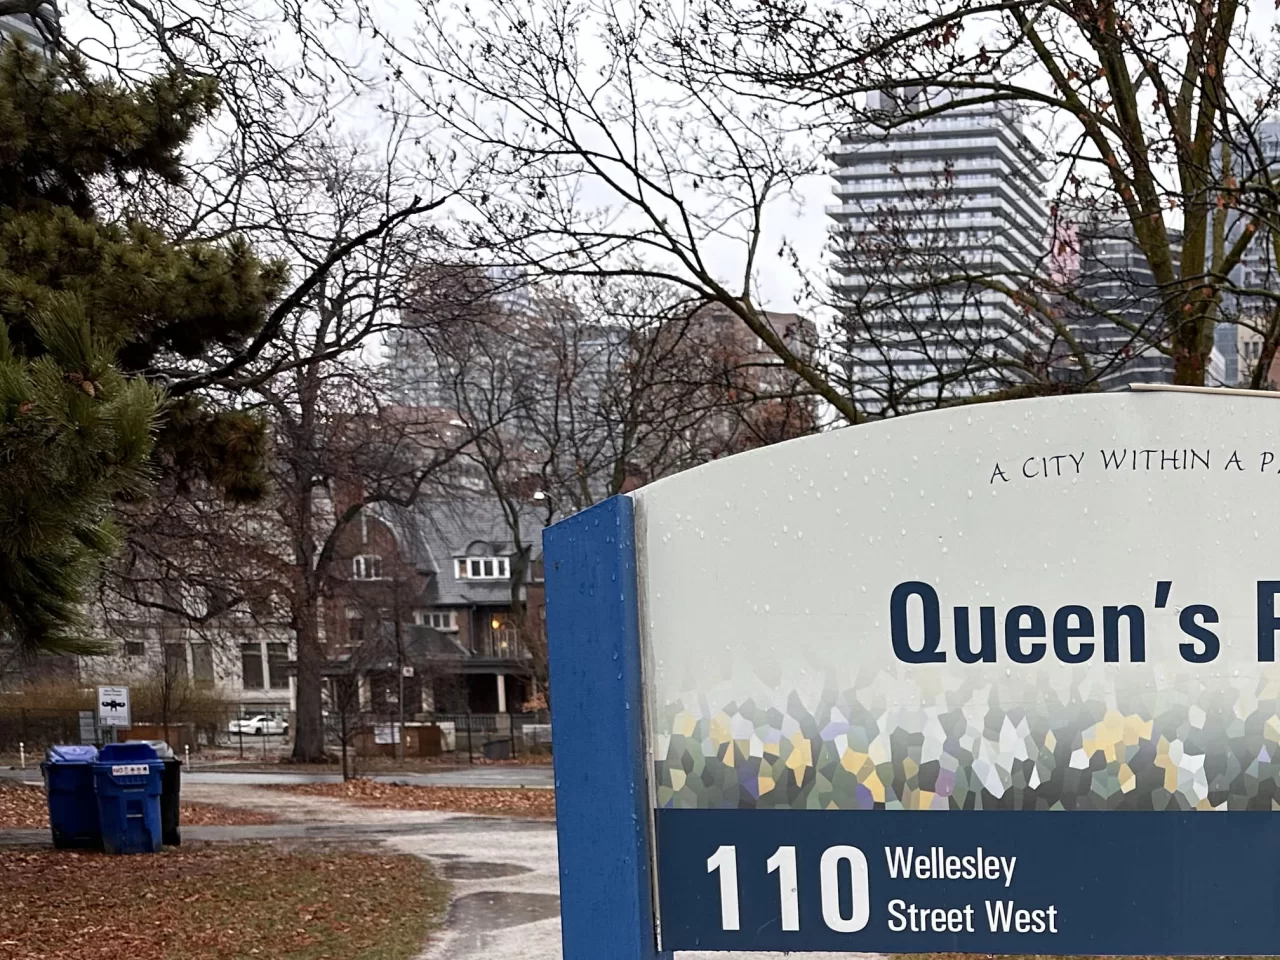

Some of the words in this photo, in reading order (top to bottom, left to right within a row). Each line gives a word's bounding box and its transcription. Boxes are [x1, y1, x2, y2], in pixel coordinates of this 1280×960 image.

[990, 462, 1009, 485] A
[1022, 451, 1085, 479] CITY
[1100, 448, 1210, 471] WITHIN
[1224, 450, 1245, 471] A
[889, 580, 1221, 664] Queen's
[884, 846, 1017, 888] Wellesley
[706, 845, 870, 933] 110
[887, 899, 975, 933] Street
[984, 900, 1058, 933] West
